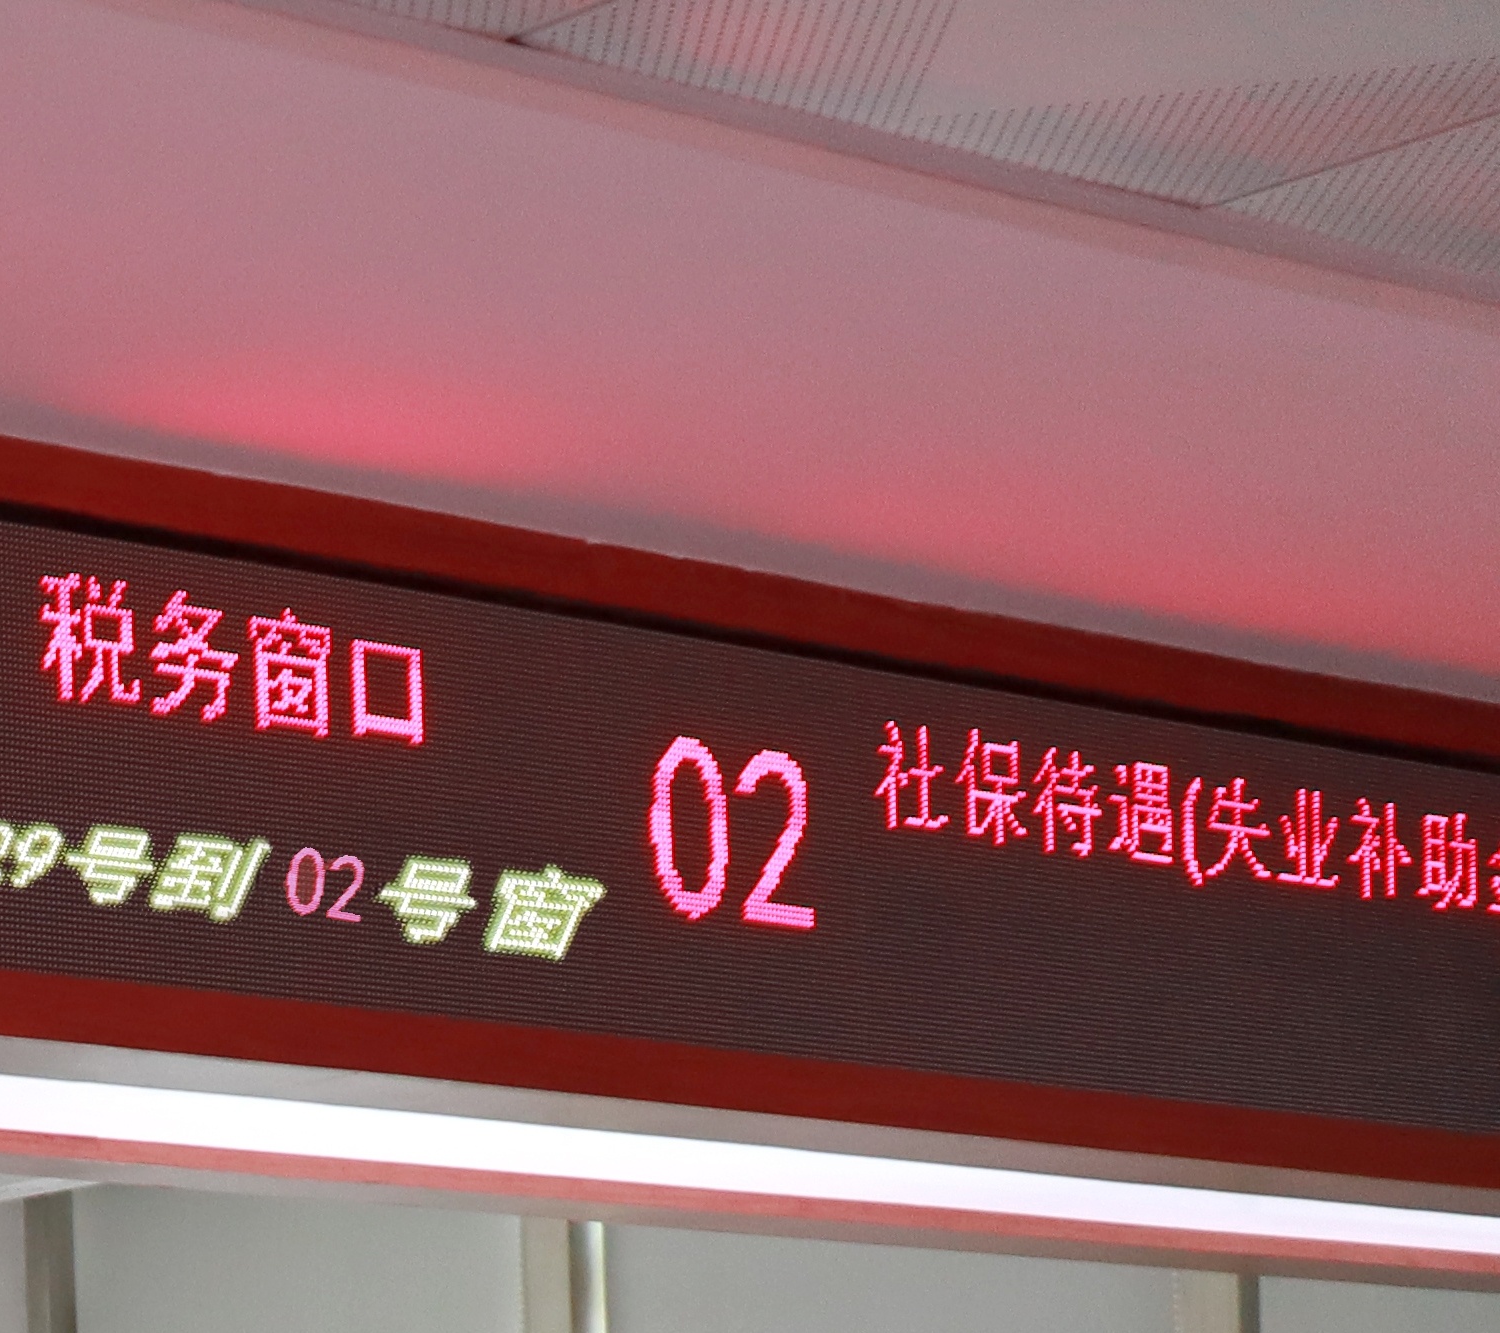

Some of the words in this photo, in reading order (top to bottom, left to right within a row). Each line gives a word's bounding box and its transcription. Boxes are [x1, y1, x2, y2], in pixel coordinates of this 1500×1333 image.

[37, 570, 429, 748] 税务窗口
[646, 735, 818, 932] 02
[875, 720, 1500, 914] 社保待遇(失业补助
